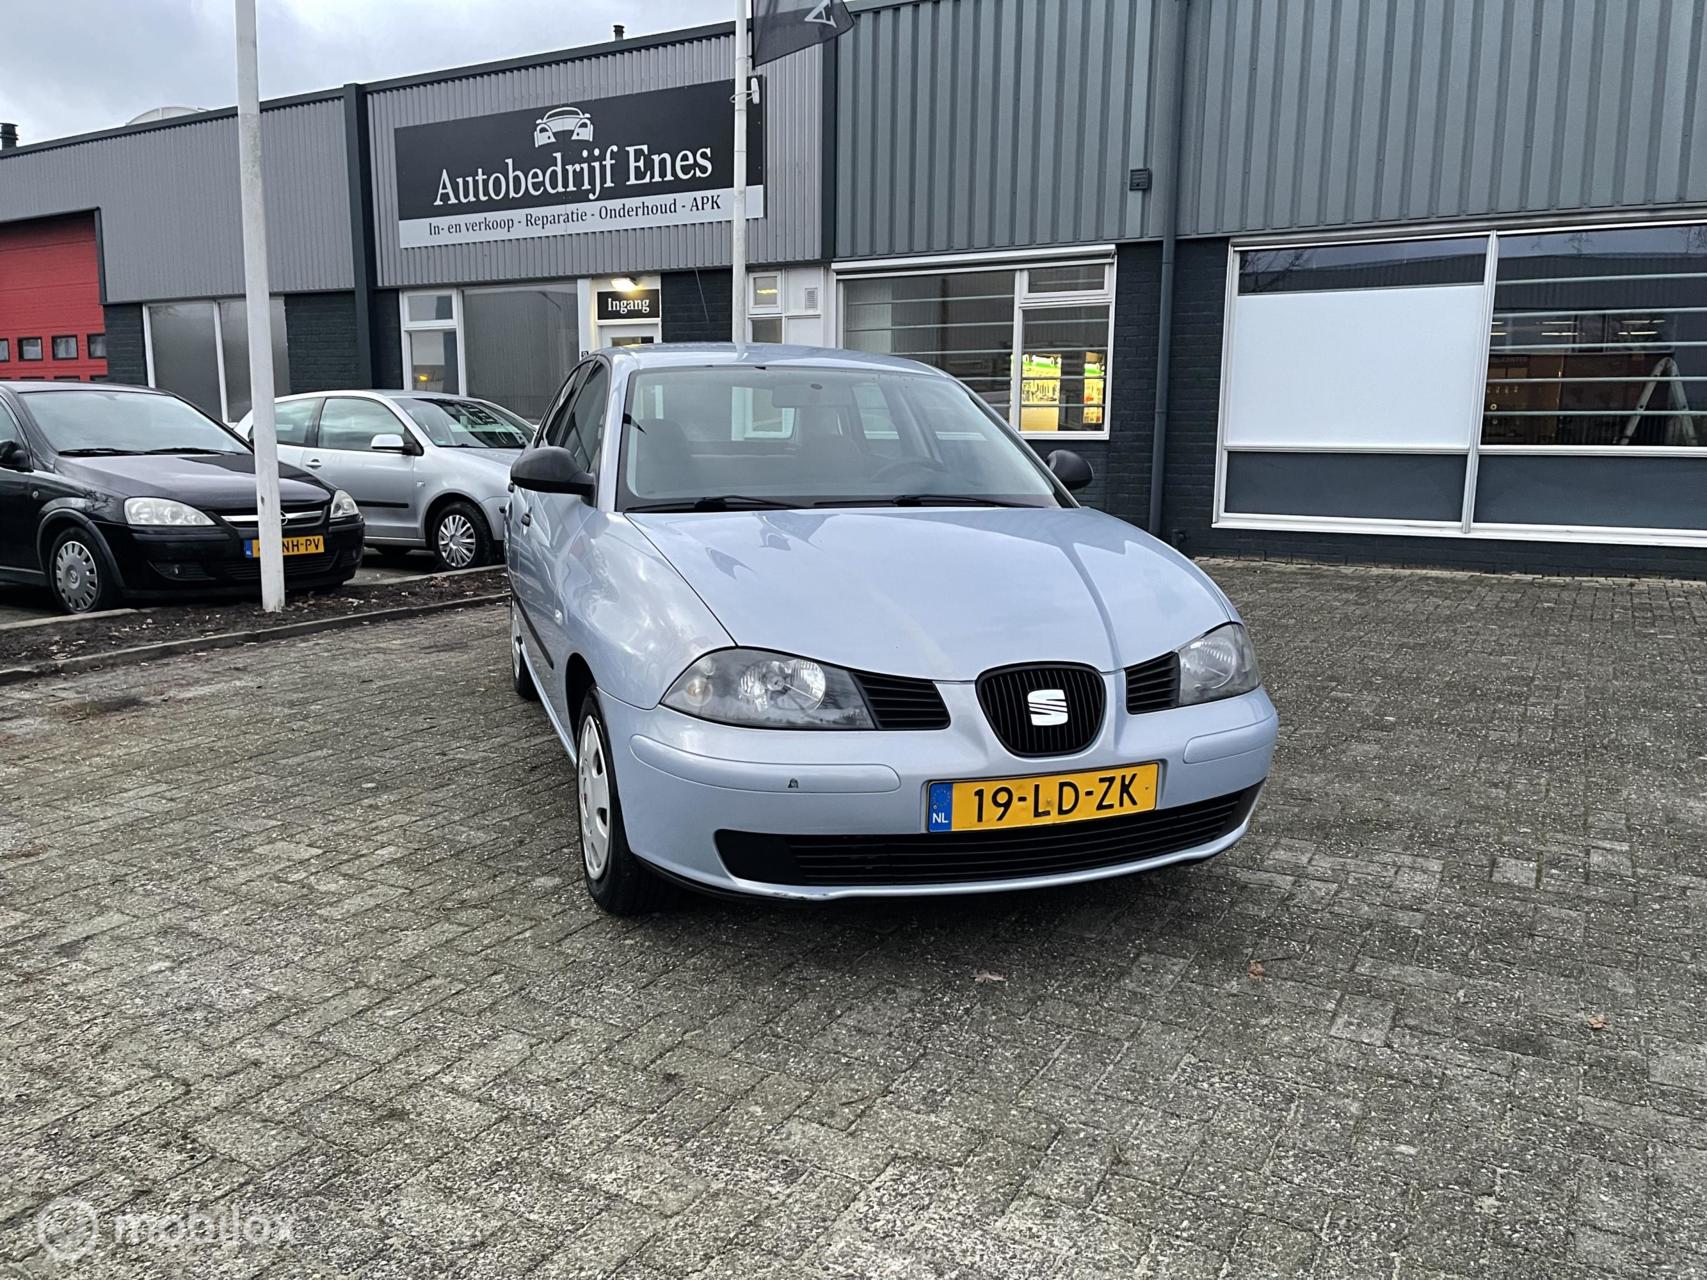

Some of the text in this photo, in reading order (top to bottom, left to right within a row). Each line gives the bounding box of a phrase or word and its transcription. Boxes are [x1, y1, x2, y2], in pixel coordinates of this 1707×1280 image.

[433, 144, 713, 206] Autobedrijf Enes
[428, 222, 445, 236] In-
[447, 222, 462, 234] en
[465, 217, 514, 233] verkoop
[525, 208, 588, 230] Reparatie
[599, 199, 677, 220] Onderhoud
[690, 194, 722, 211] APK
[607, 297, 650, 314] Ingang
[932, 812, 949, 824] NL
[973, 773, 1138, 823] 19-LD-ZK
